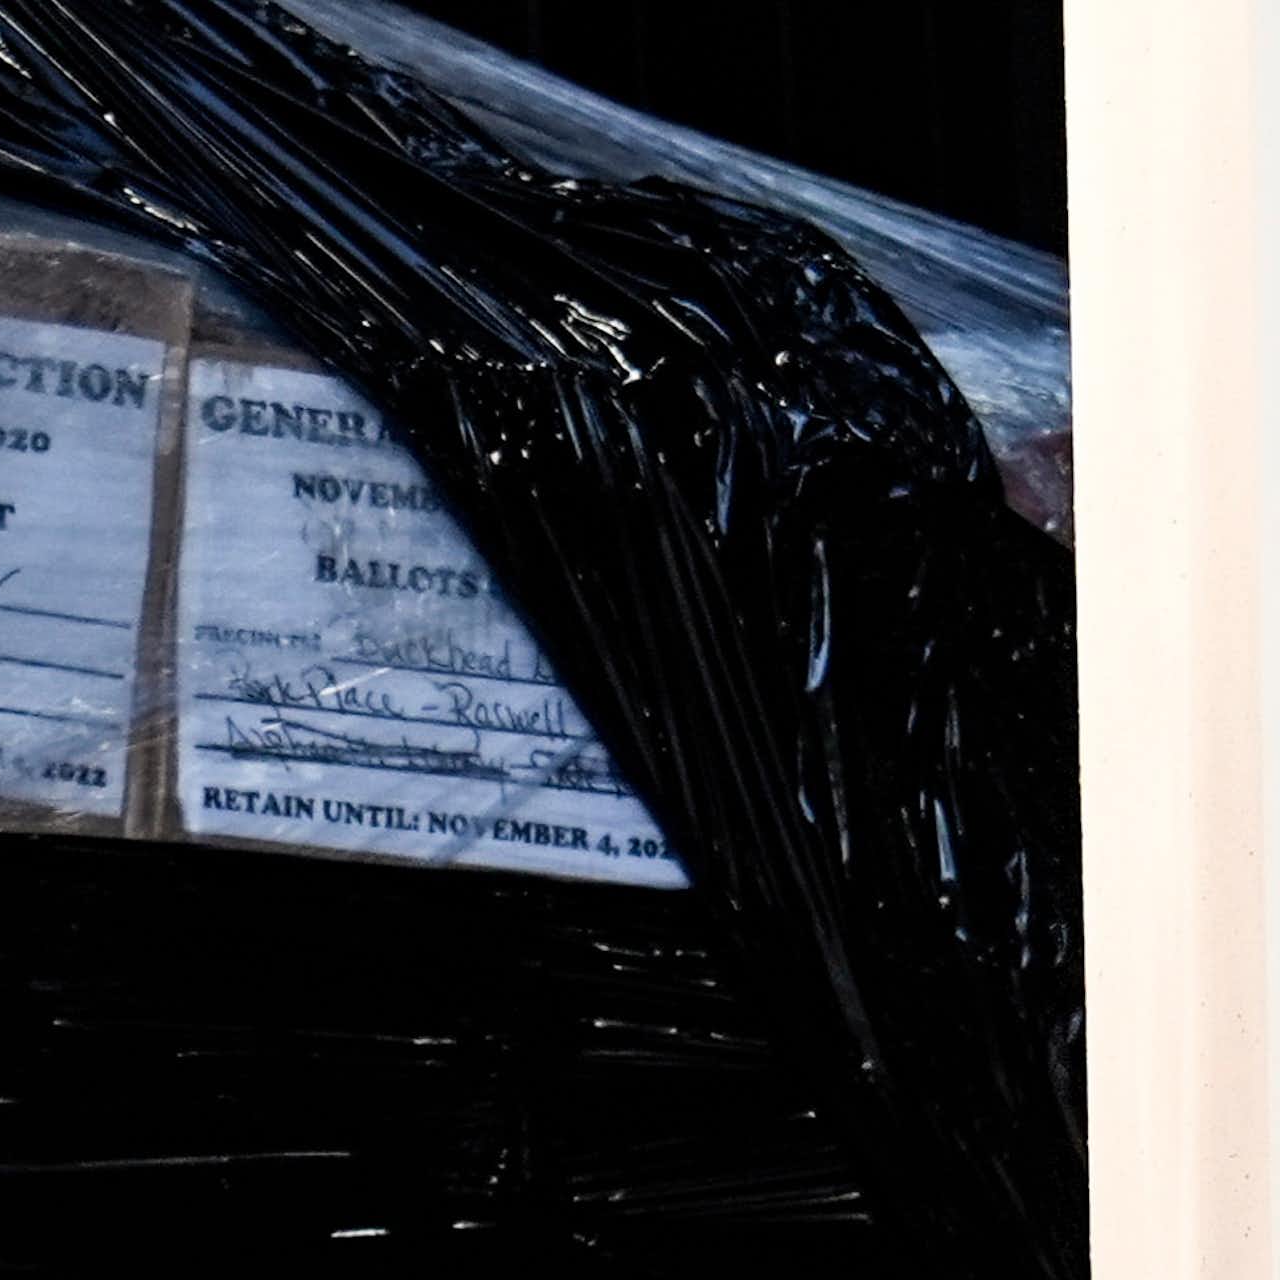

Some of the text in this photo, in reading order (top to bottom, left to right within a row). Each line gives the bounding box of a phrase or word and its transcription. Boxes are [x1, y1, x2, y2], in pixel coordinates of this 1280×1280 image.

[315, 554, 482, 598] BALLOTS
[203, 786, 315, 823] RETAIN
[322, 801, 420, 831] UNTIL:
[427, 811, 589, 850] NOEMBER
[596, 834, 620, 857] 4,
